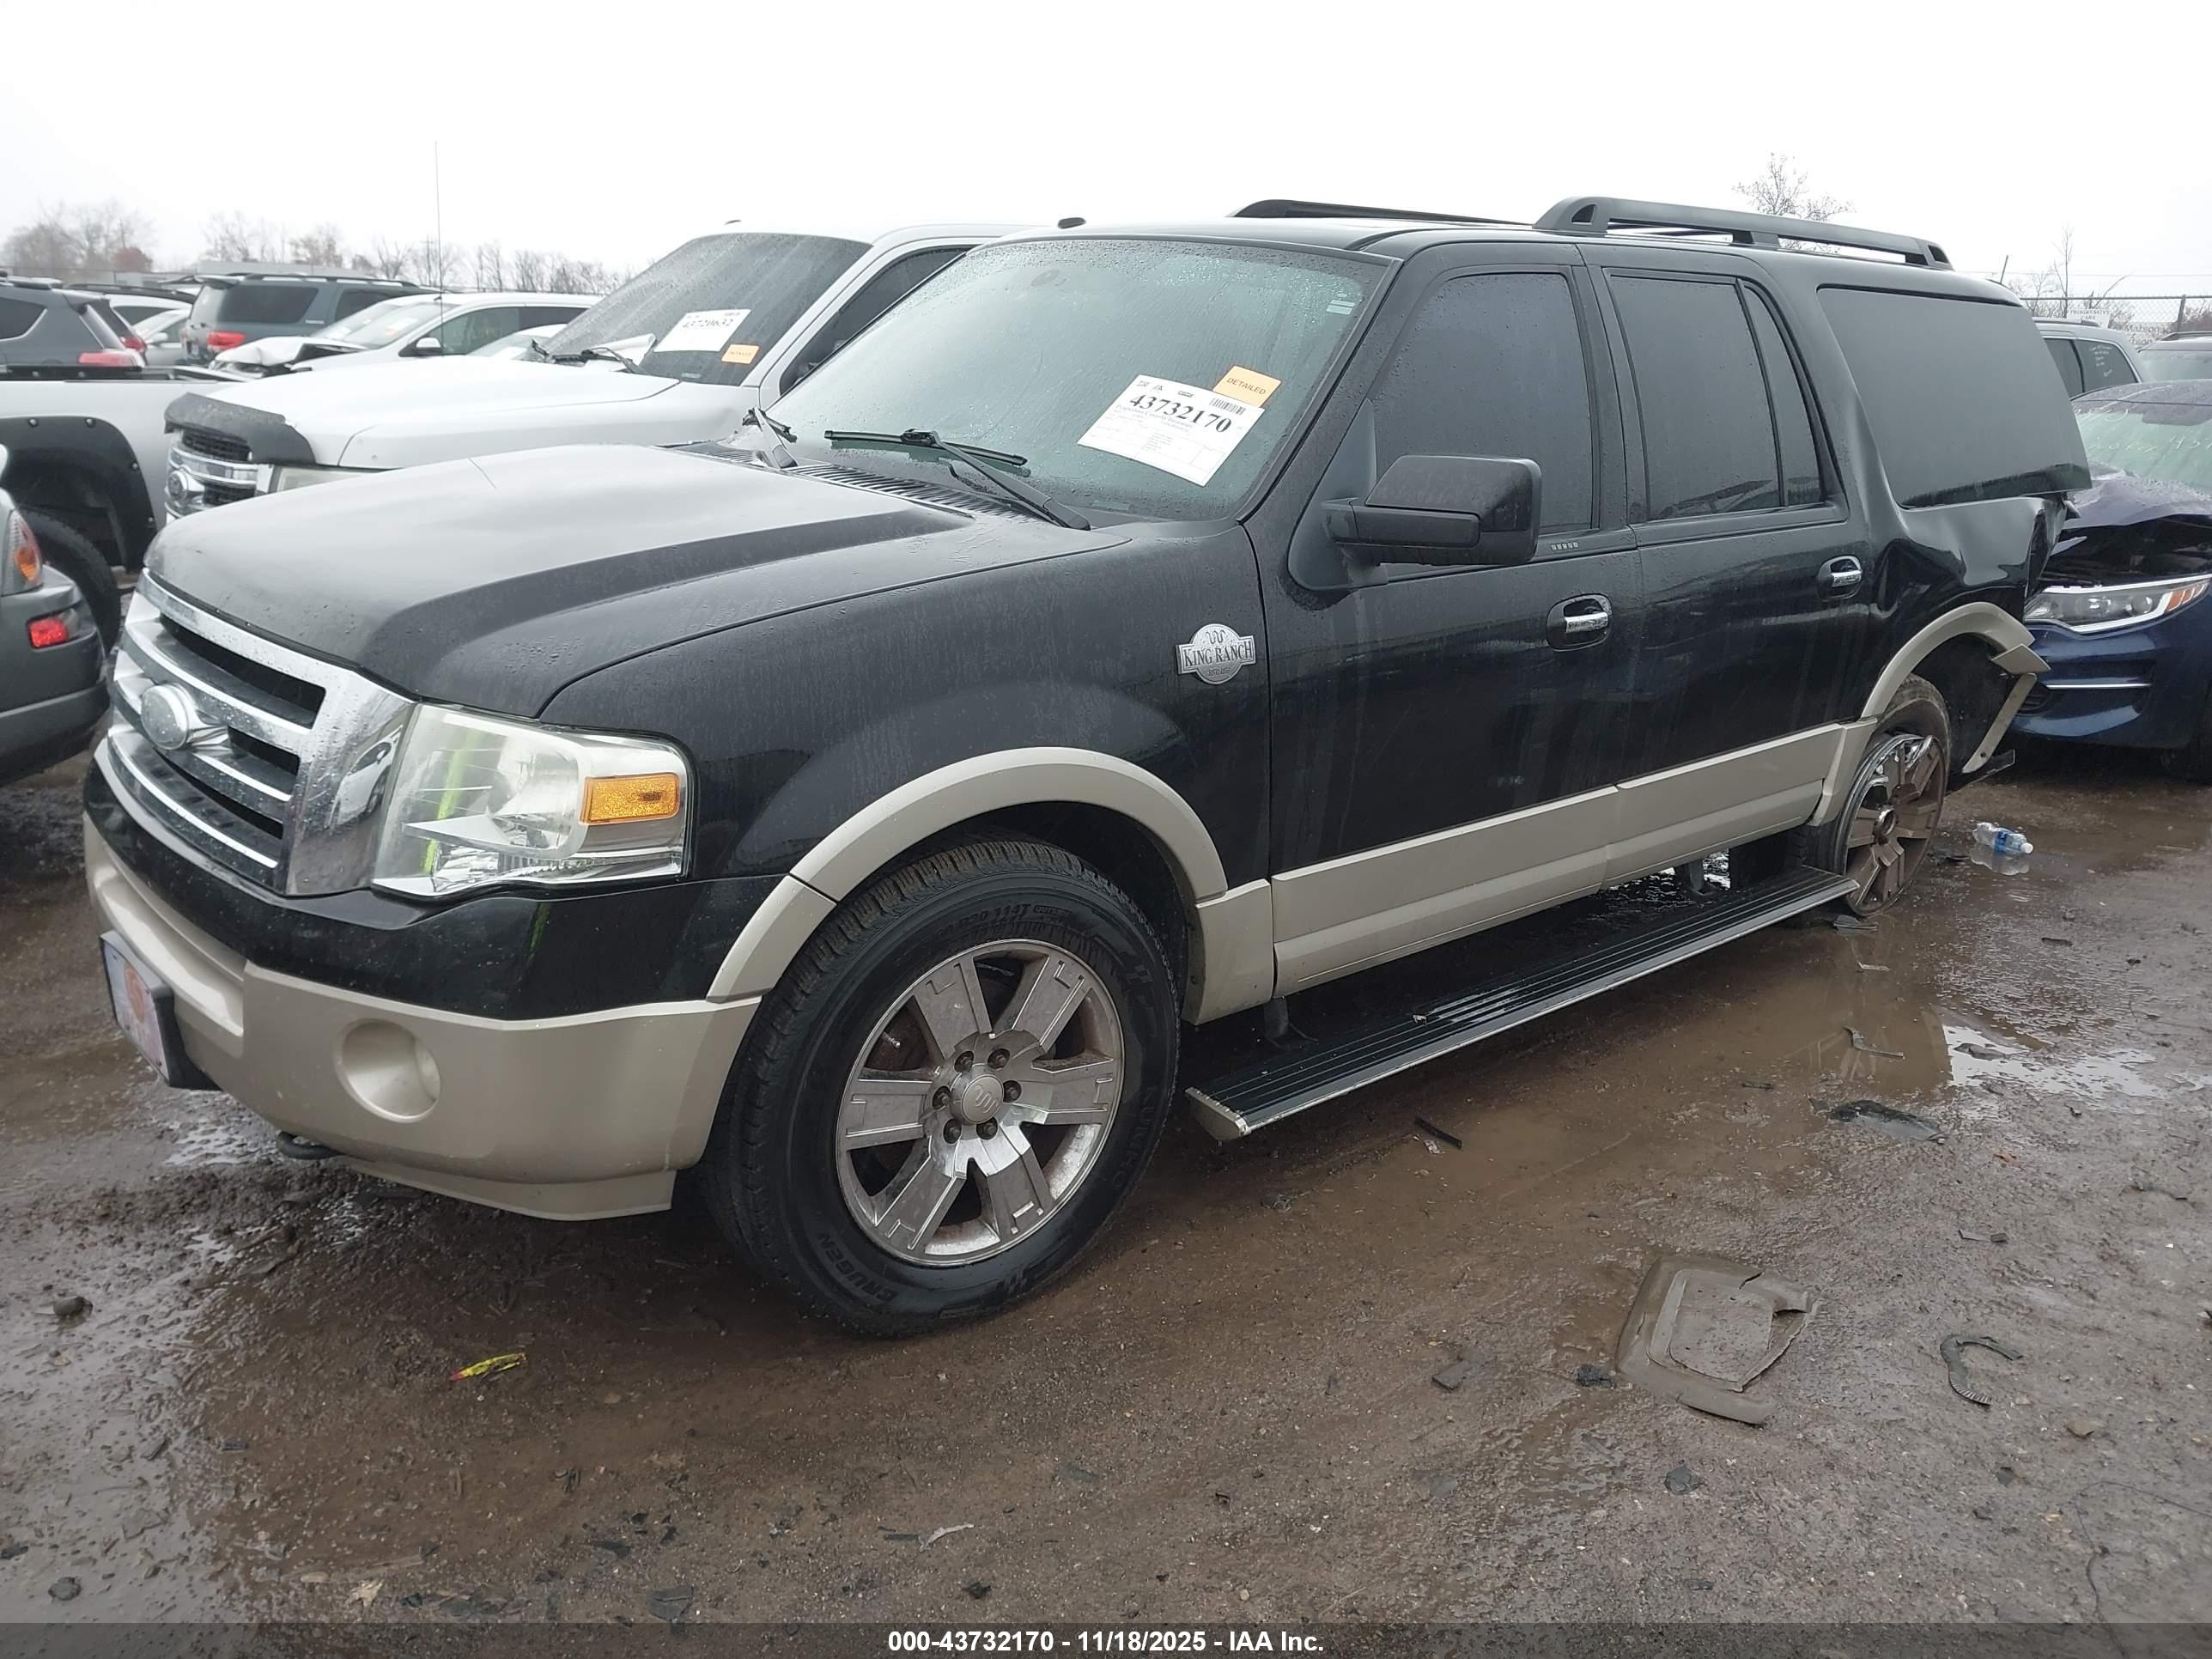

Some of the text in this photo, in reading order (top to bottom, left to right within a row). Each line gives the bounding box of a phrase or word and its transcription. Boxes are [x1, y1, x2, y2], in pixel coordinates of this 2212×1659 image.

[1225, 376, 1267, 396] DETAILED
[1129, 393, 1233, 433] 43732170
[1183, 641, 1253, 666] KING RANCH
[817, 1233, 899, 1302] CRUGEN
